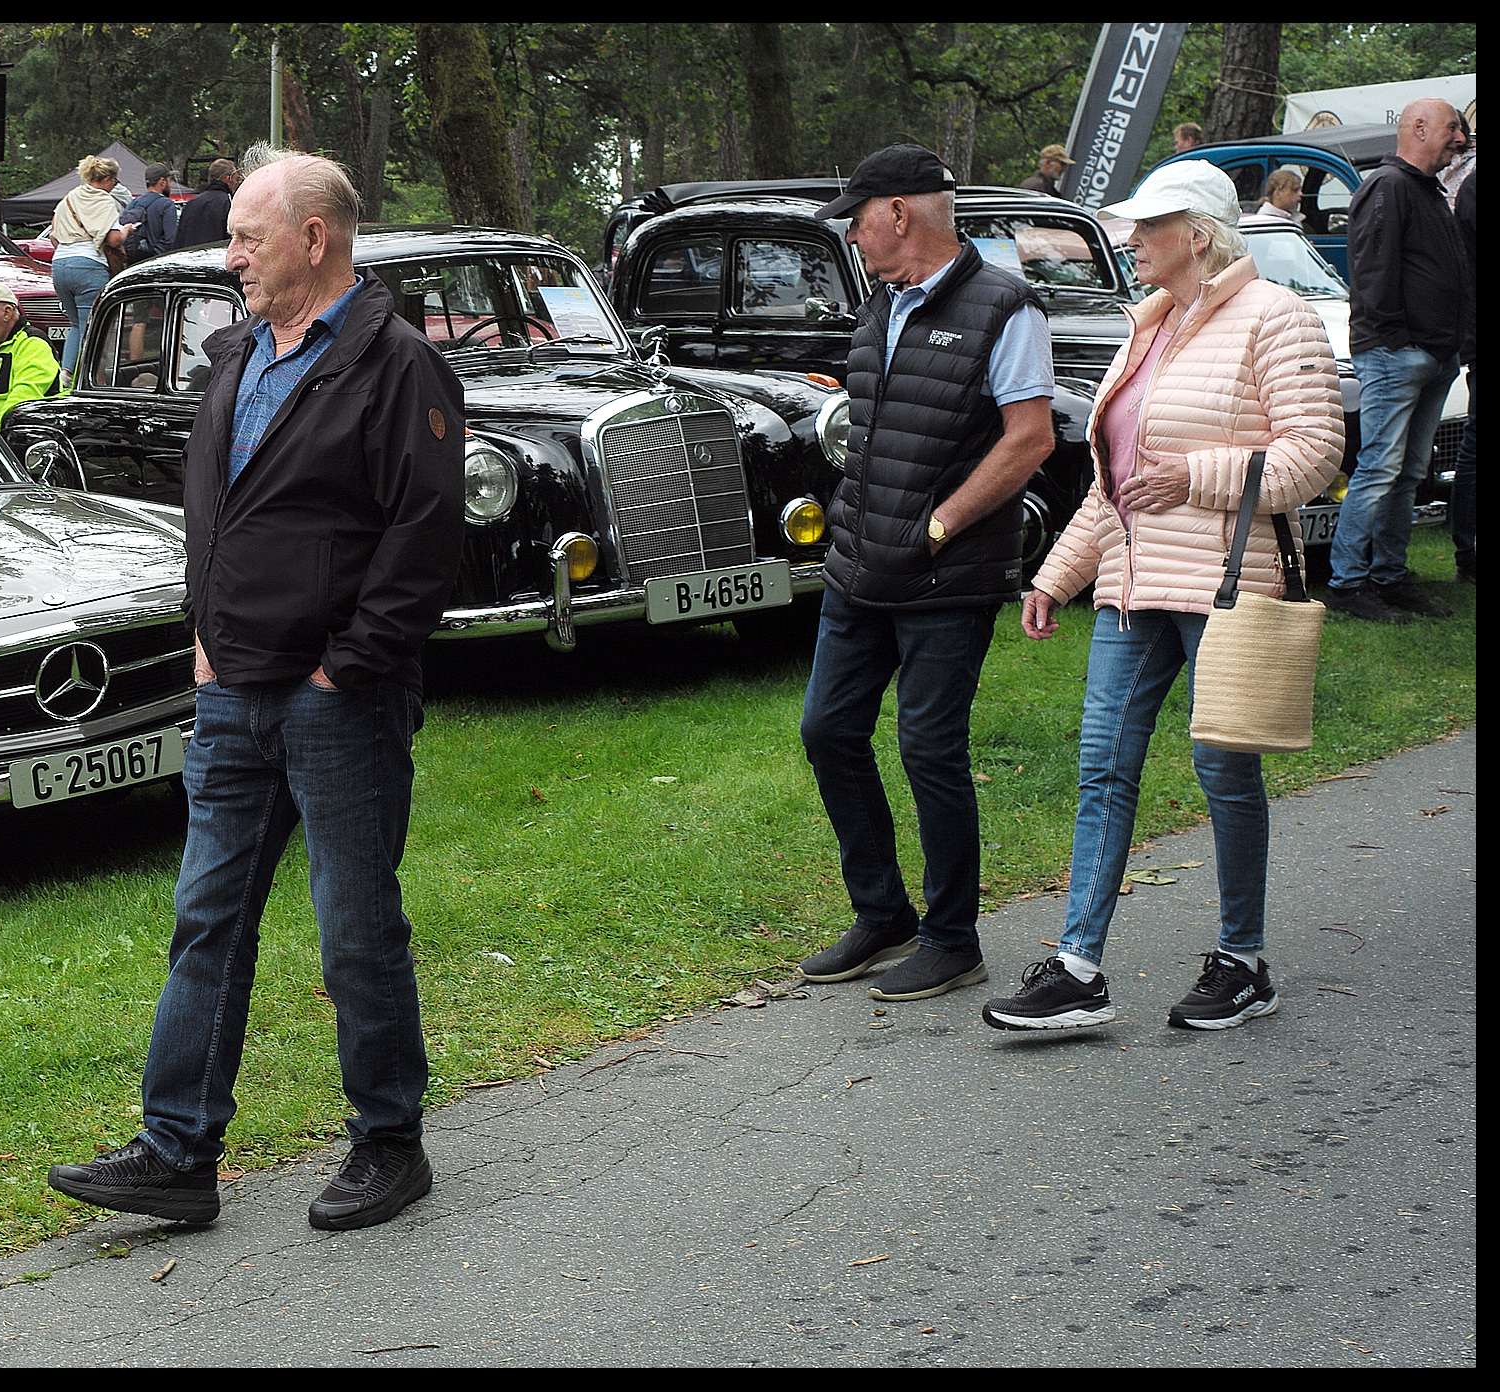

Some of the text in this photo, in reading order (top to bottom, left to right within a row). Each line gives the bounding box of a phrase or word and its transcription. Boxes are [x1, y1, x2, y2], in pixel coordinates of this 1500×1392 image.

[51, 328, 66, 339] ZX
[675, 571, 764, 614] B-4658
[31, 734, 163, 800] C-25067
